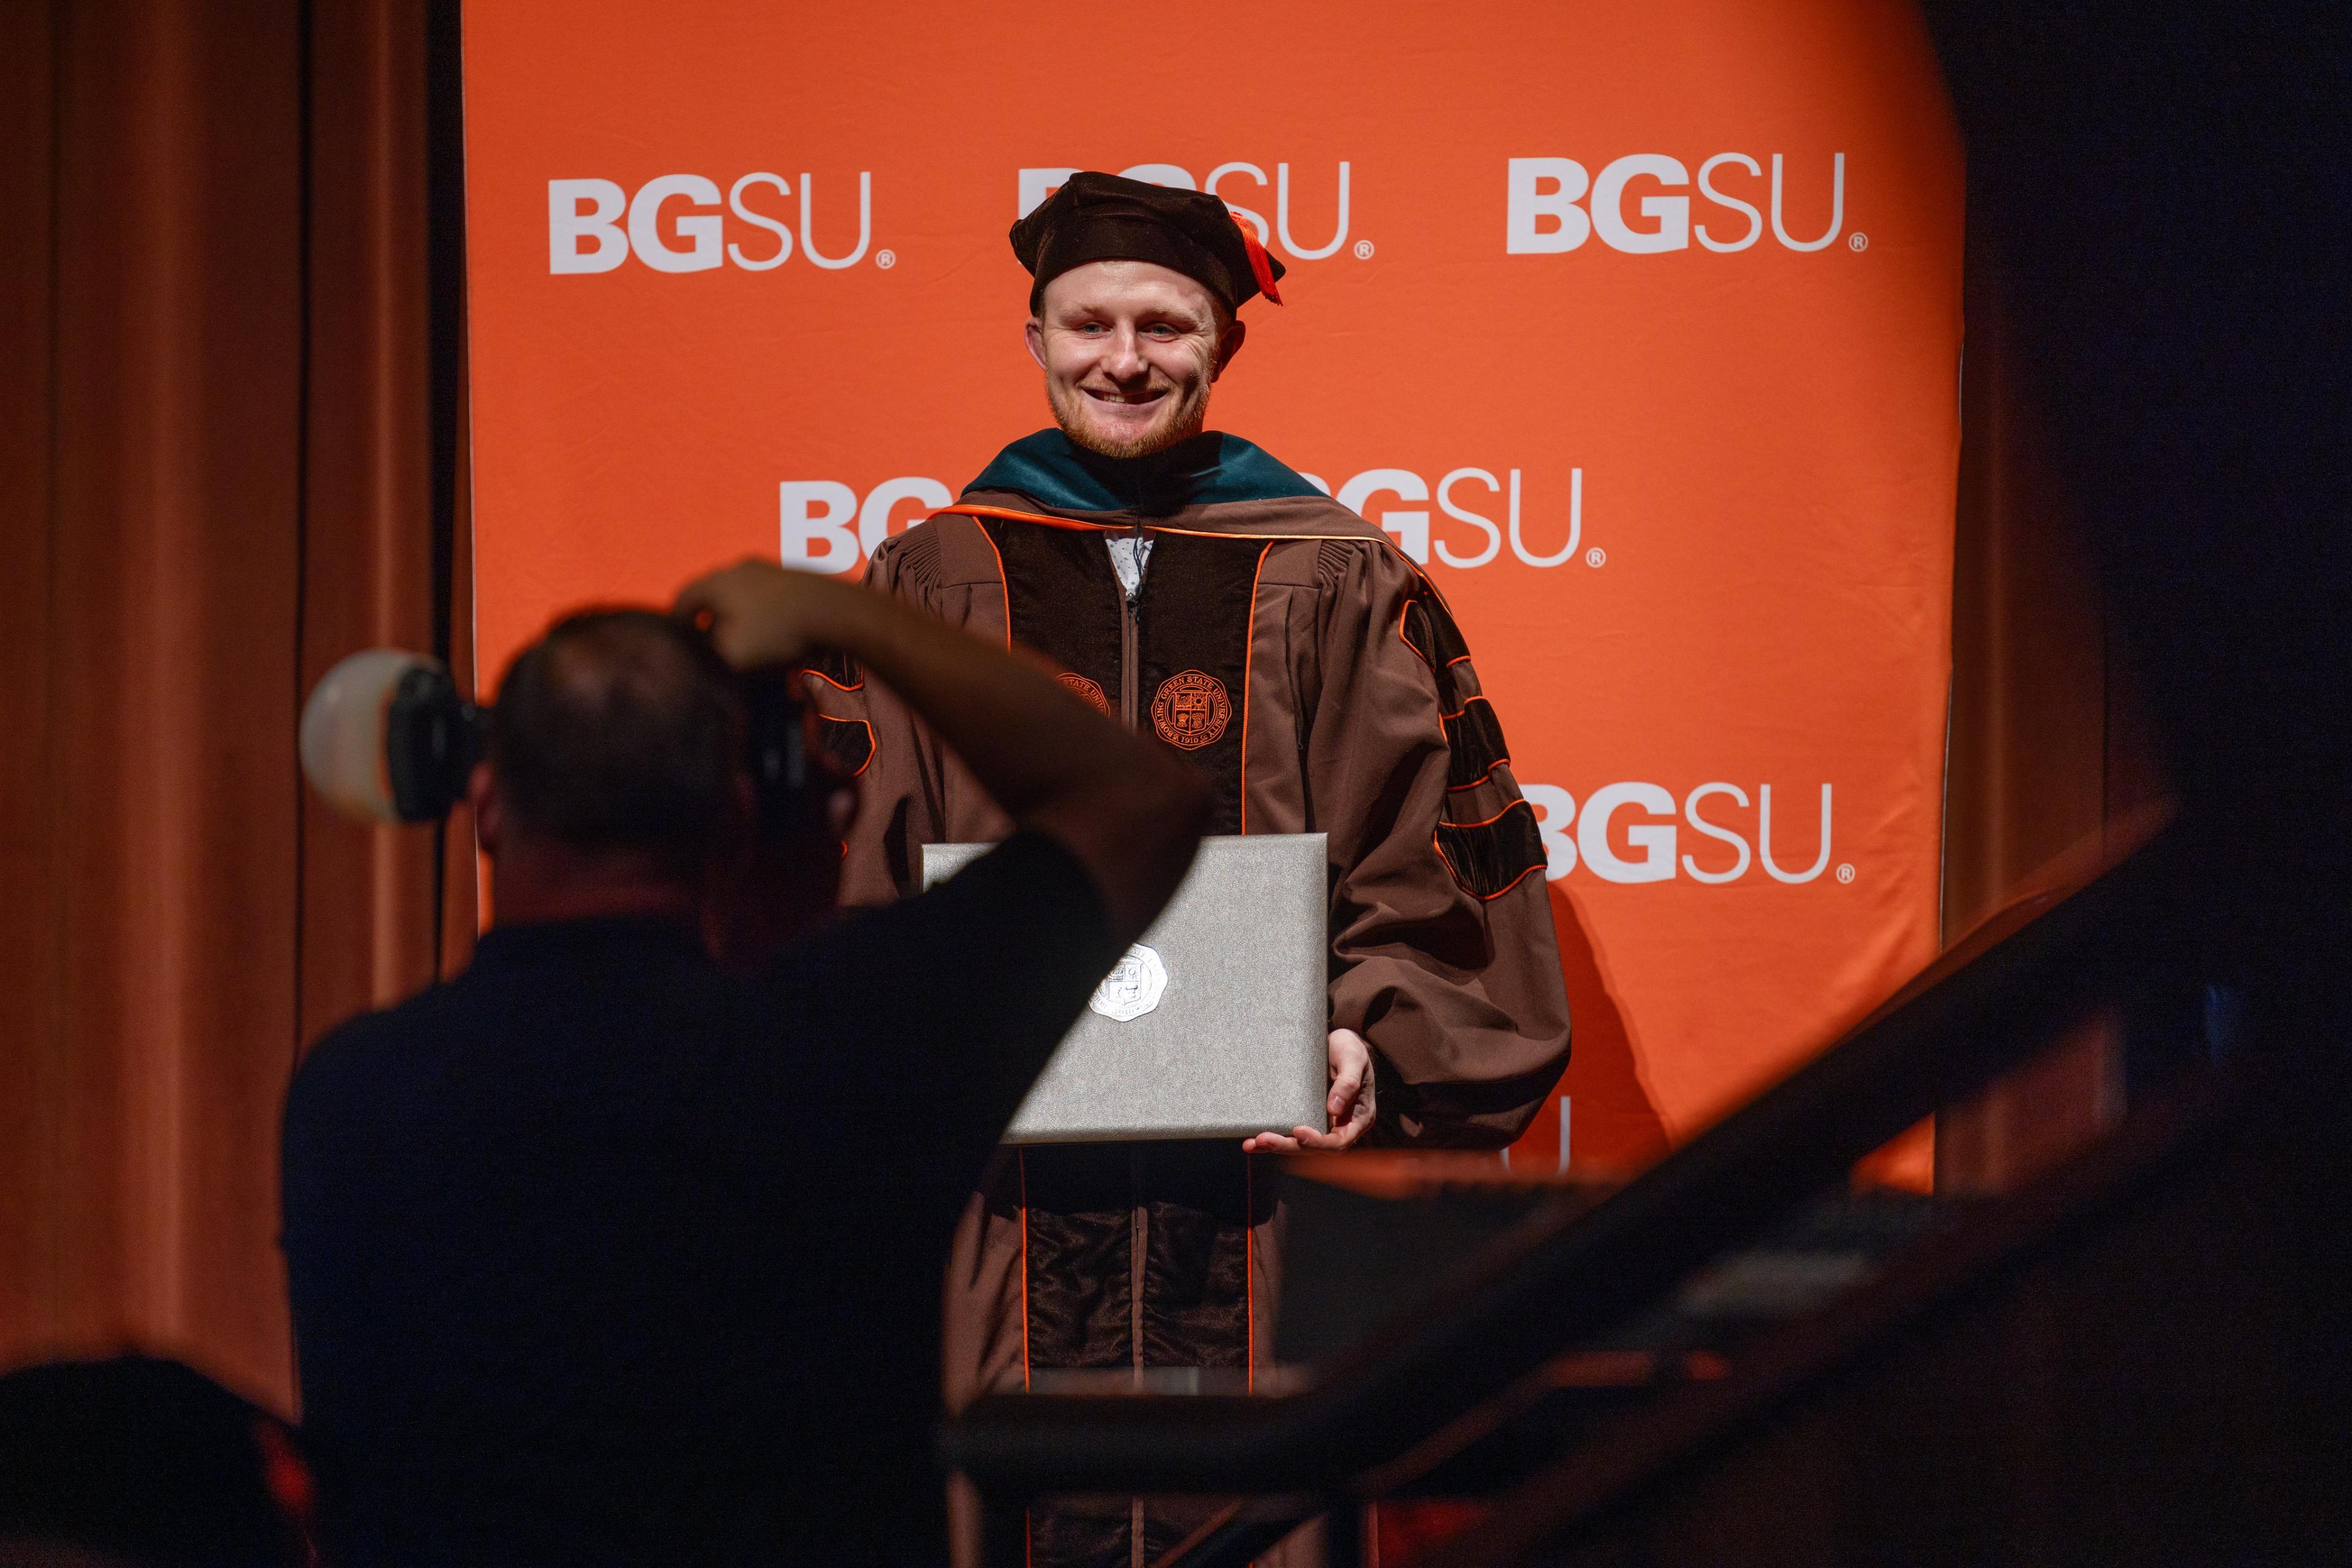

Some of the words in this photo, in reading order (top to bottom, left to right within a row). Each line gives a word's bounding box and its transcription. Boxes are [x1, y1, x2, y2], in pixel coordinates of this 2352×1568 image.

[1161, 677, 1184, 699] GREEN
[1187, 676, 1214, 689] STATE
[1157, 701, 1173, 738] BOWLING
[1209, 688, 1226, 737] UNIVERSITY
